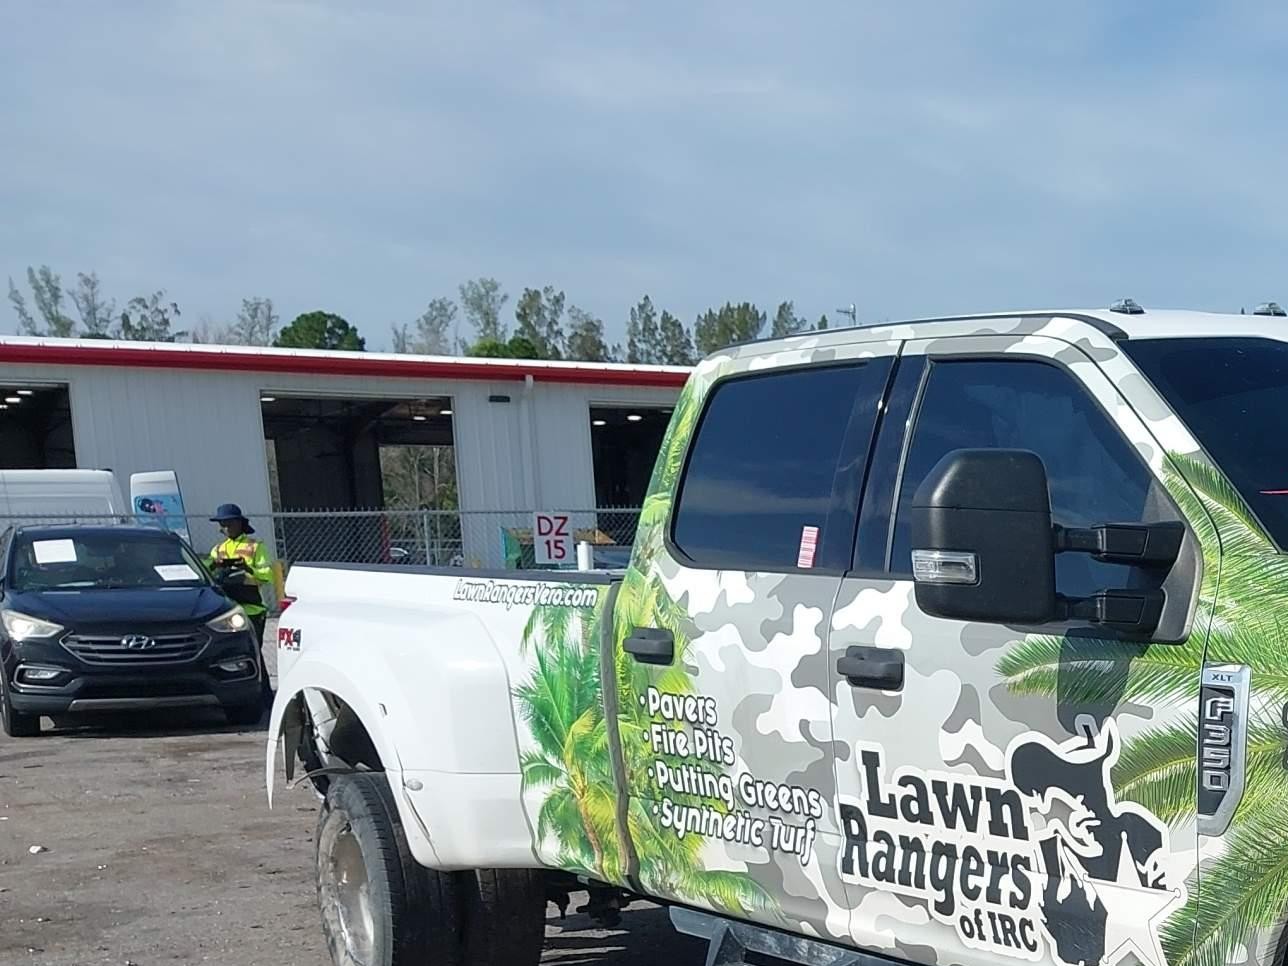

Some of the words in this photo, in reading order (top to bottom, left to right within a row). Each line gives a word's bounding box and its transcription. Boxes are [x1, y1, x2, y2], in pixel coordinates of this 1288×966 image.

[537, 516, 569, 536] DZ
[544, 540, 565, 559] 15
[453, 579, 599, 611] LawnRangersVero.com
[1211, 673, 1233, 682] XLT
[649, 722, 689, 757] Fire
[692, 728, 736, 766] Pits
[654, 760, 735, 811] Putting
[738, 772, 823, 820] Greens
[861, 749, 1030, 841] Lawn
[660, 797, 767, 846] Synthetic
[768, 816, 817, 867] Turf
[839, 803, 1032, 917] Rangers
[960, 908, 987, 941] of
[987, 911, 1038, 953] IRC
